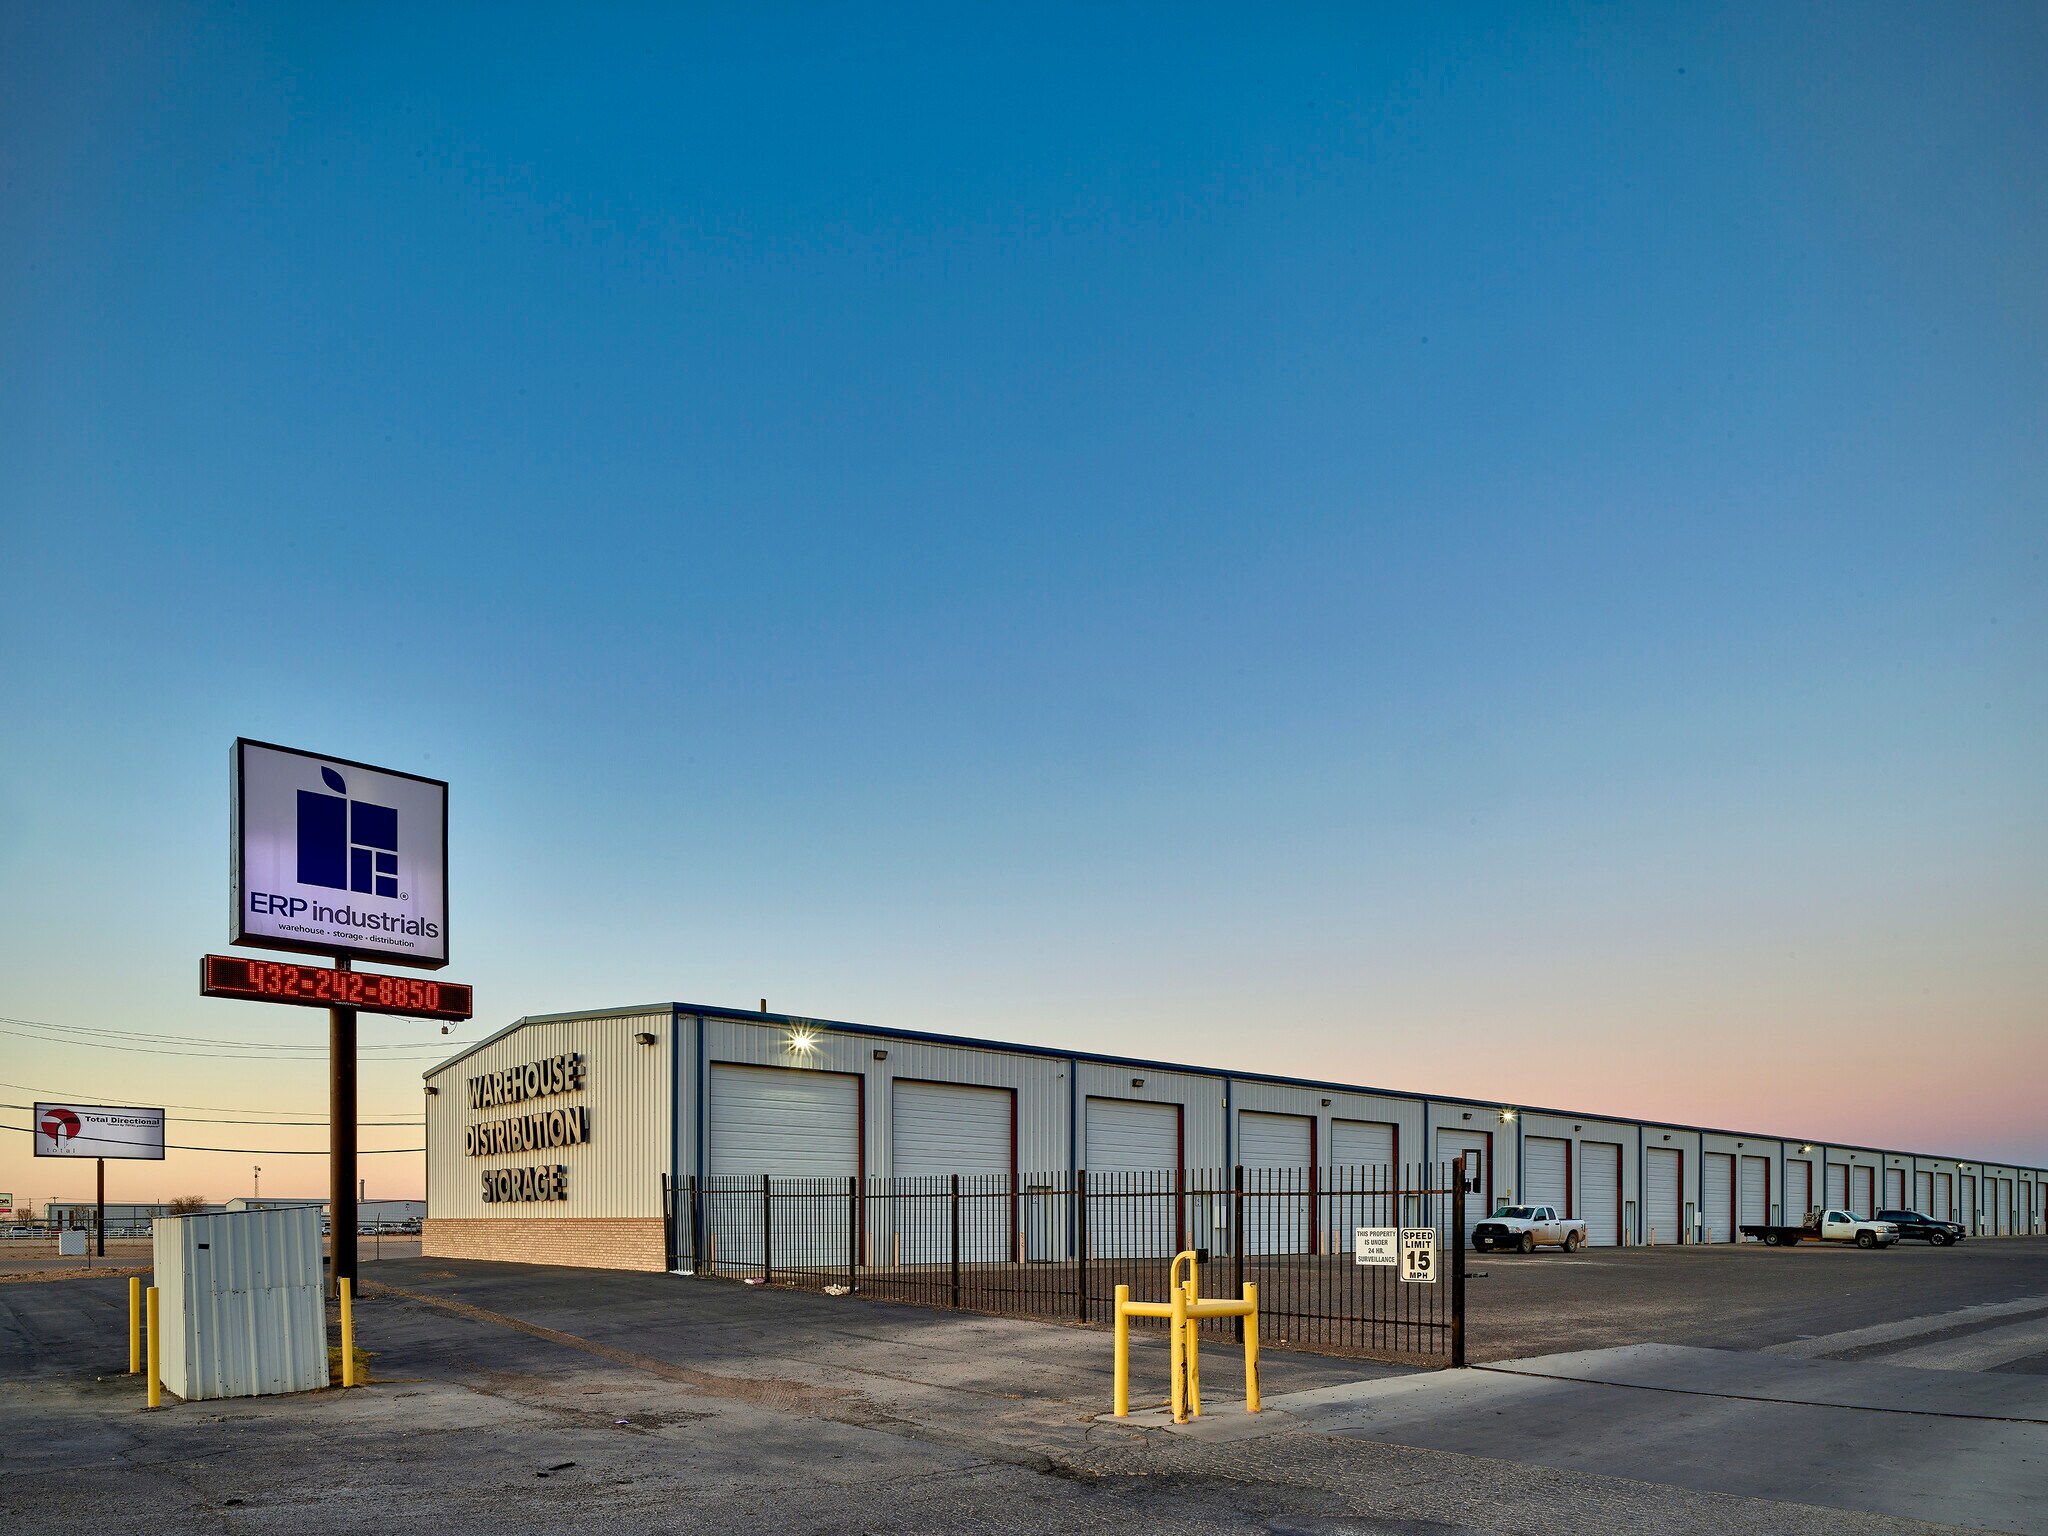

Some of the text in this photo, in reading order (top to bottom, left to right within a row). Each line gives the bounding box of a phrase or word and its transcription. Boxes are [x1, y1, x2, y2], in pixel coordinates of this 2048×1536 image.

[250, 891, 440, 939] ERP industrials
[278, 923, 415, 948] warehouse storage distribution
[249, 961, 439, 1010] 432-242-8850
[467, 1053, 583, 1109] WAREHOUSE
[85, 1115, 108, 1123] Total
[111, 1116, 160, 1125] Directional
[465, 1106, 587, 1157] DISTRIBUTION
[482, 1165, 567, 1203] STORAGE
[1403, 1232, 1433, 1240] SPEED
[1407, 1251, 1431, 1271] 15
